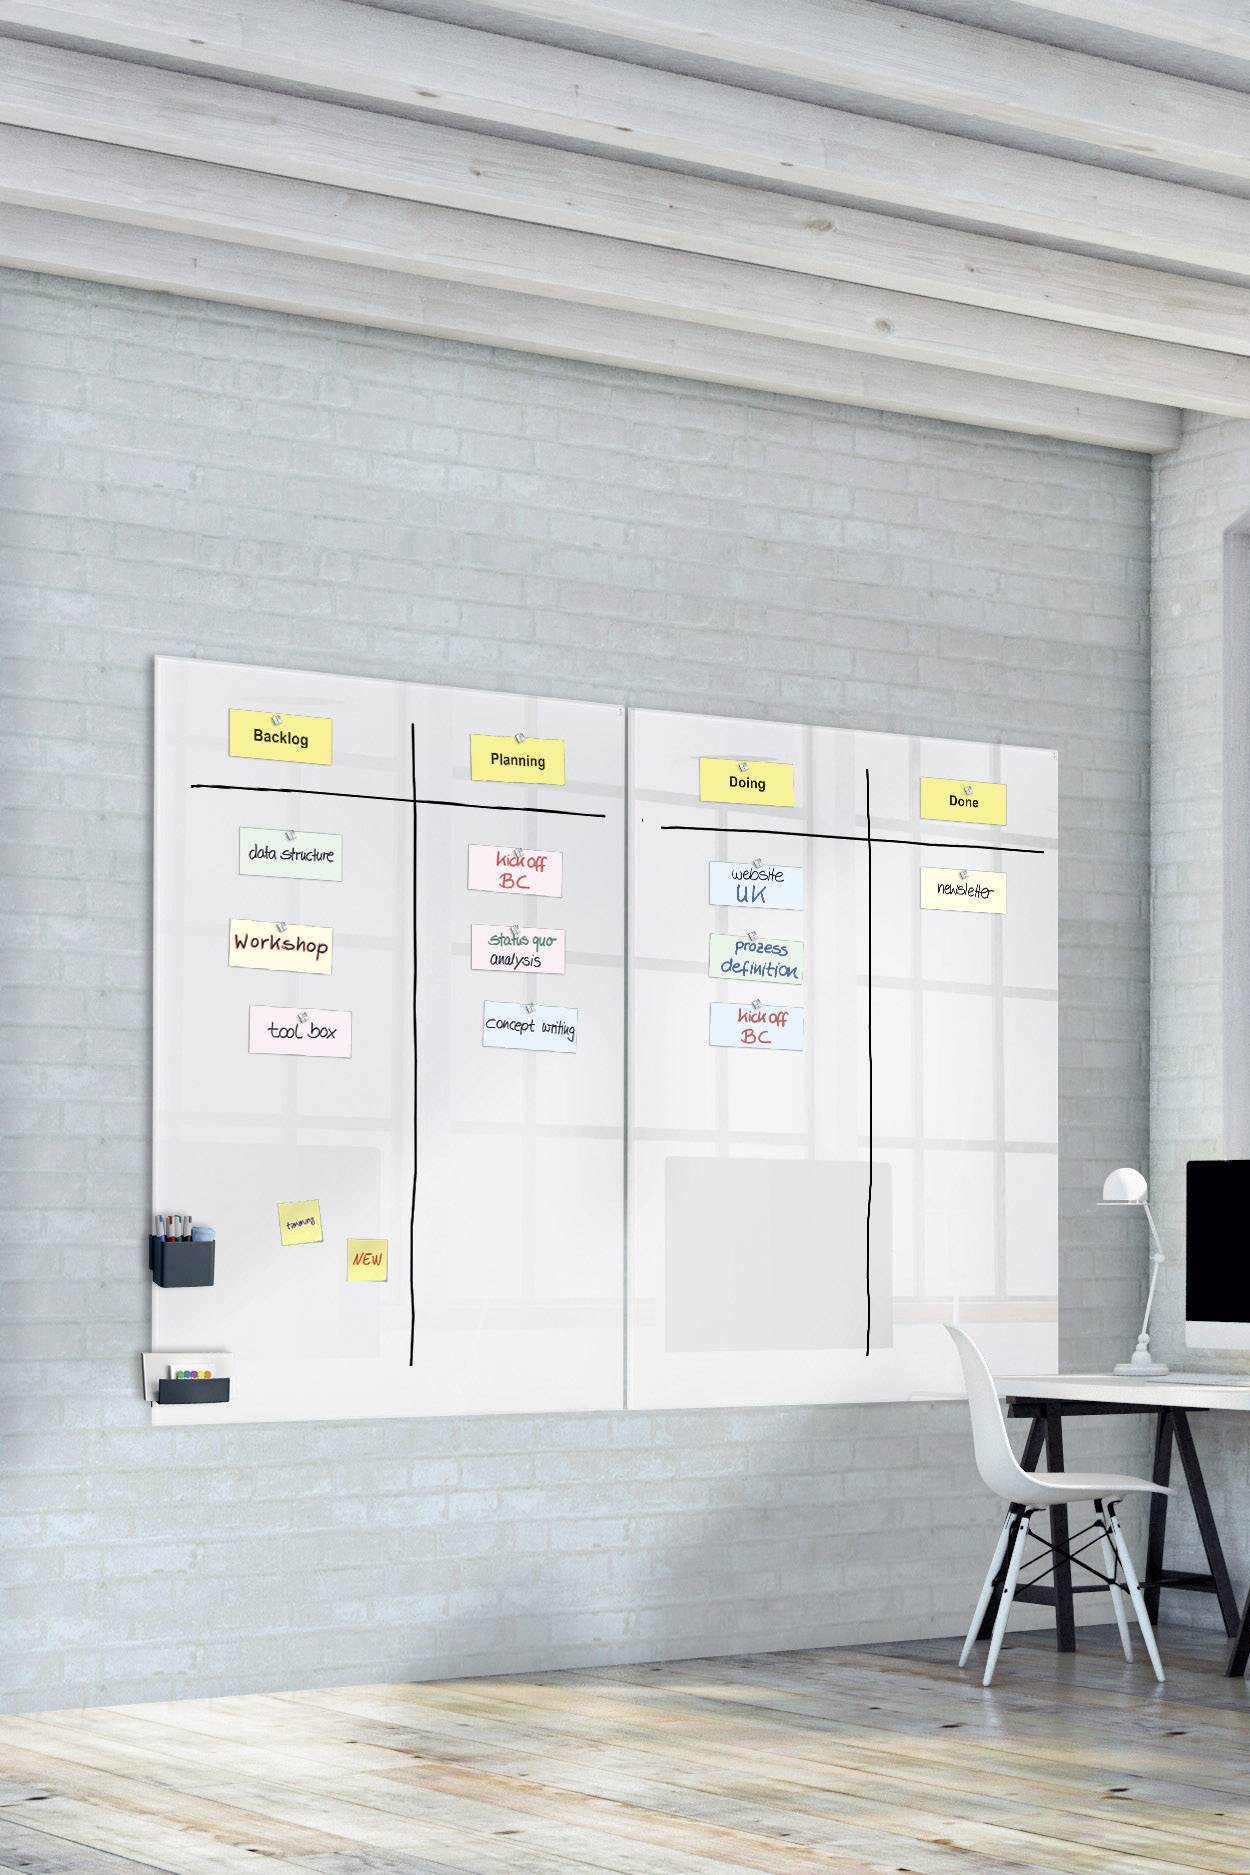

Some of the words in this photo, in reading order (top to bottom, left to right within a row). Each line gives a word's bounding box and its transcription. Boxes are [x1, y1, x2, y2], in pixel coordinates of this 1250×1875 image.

[253, 729, 309, 749] Backlog
[491, 753, 546, 770] Planning
[729, 776, 766, 792] Doing
[949, 795, 979, 809] Done
[249, 844, 277, 861] data
[279, 847, 334, 864] structure
[496, 850, 526, 867] kick
[526, 853, 548, 872] off
[499, 873, 531, 889] BC
[731, 867, 785, 882] website
[736, 885, 766, 903] UK
[937, 882, 995, 899] newsletter
[234, 934, 328, 961] Workshop
[487, 932, 529, 947] status
[532, 936, 557, 954] quo
[735, 939, 789, 957] prozess
[489, 951, 542, 970] analysis
[721, 959, 799, 980] definition
[738, 1008, 766, 1024] kick
[767, 1010, 789, 1027] off
[268, 1022, 303, 1039] tool
[307, 1023, 337, 1039] box
[484, 1017, 535, 1034] concept
[541, 1021, 575, 1042] writing
[741, 1029, 772, 1045] BC
[352, 1252, 383, 1267] NEW
